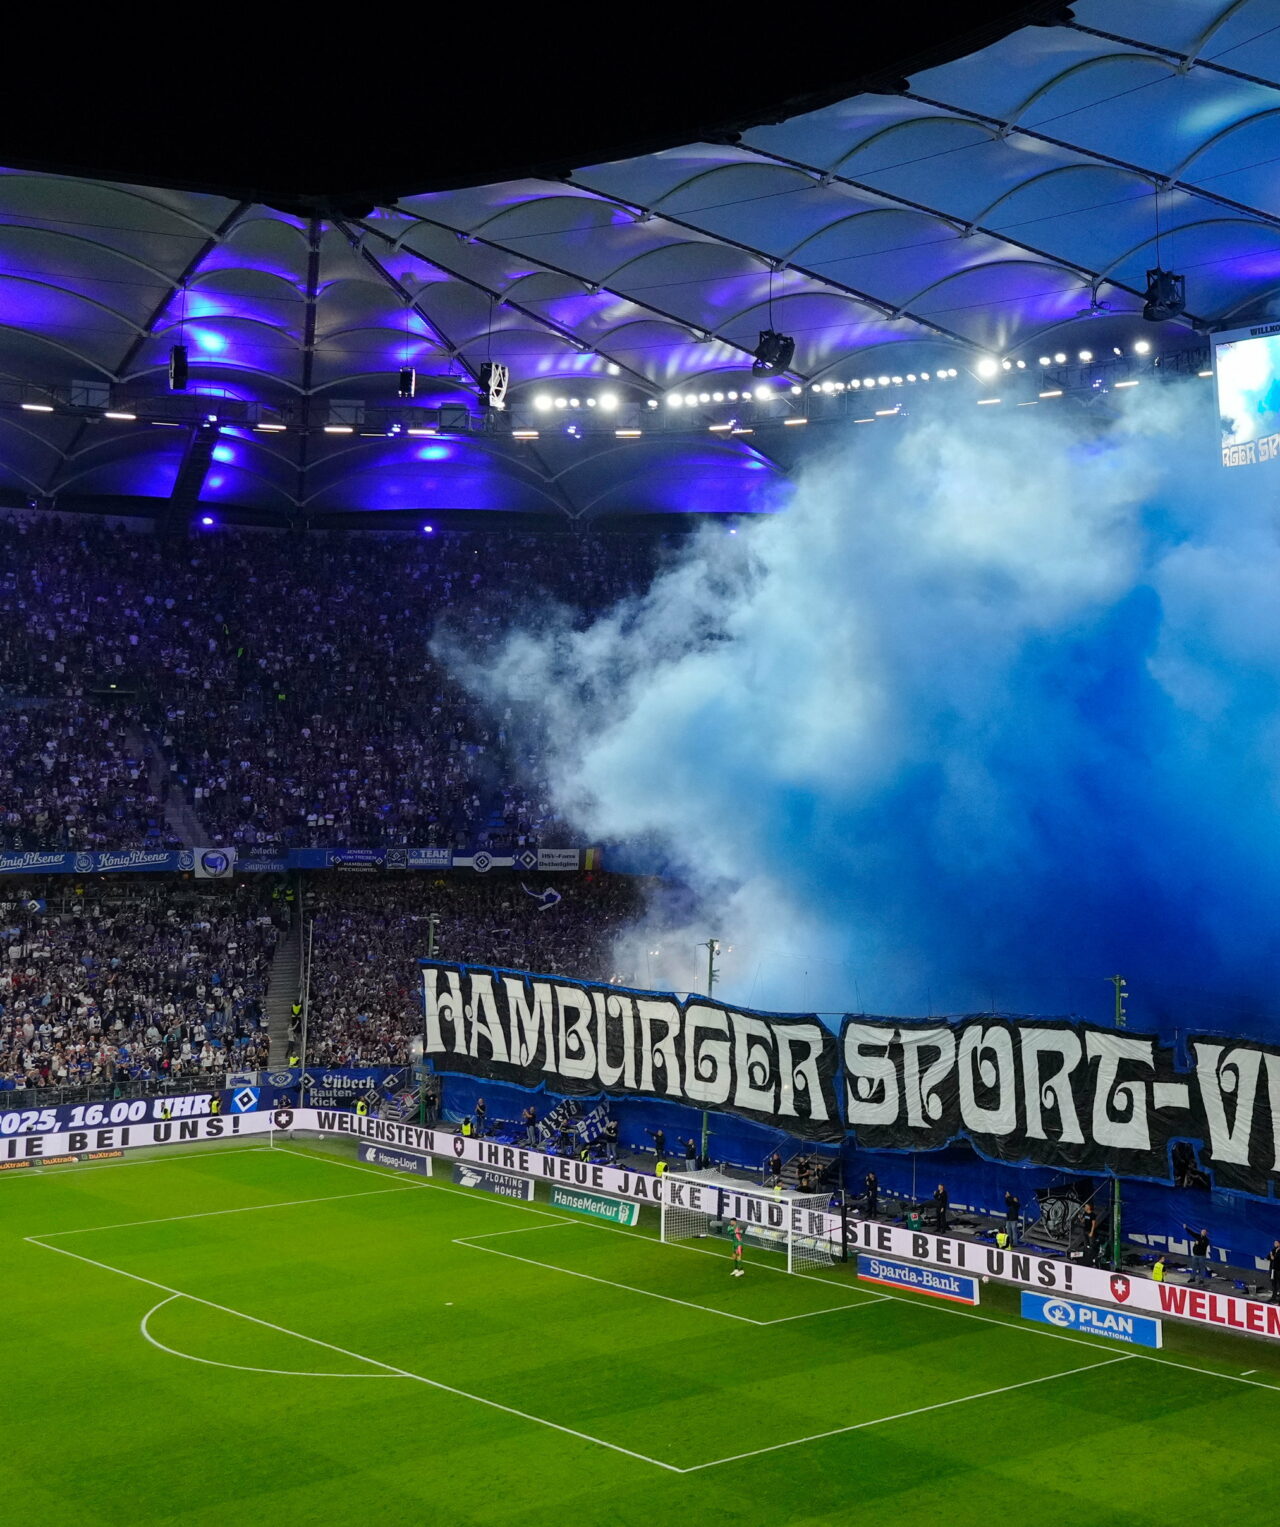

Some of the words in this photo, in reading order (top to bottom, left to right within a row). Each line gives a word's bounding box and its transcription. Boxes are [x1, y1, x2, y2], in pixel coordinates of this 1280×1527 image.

[23, 850, 65, 865] Pilsener
[98, 853, 131, 868] König
[129, 850, 170, 864] Pilsener
[420, 849, 449, 858] TEAM
[244, 862, 285, 872] Supporters
[421, 968, 830, 1121] HAMBURGER
[322, 1074, 375, 1088] Lübeck
[310, 1088, 356, 1098] Rauten-
[310, 1096, 337, 1107] Kick
[0, 1108, 62, 1134] 025,
[68, 1101, 147, 1128] 16.00
[153, 1094, 213, 1120] UHR
[317, 1111, 435, 1150] WELLENSTEYN
[68, 1127, 130, 1152] BEI
[88, 1150, 123, 1160] buXtrade
[378, 1153, 417, 1170] Hapag-Lloyd
[484, 1173, 523, 1189] FLOATING
[494, 1184, 523, 1199] HOMES
[554, 1190, 618, 1218] HanseMerkur
[478, 1142, 530, 1172] IHRE
[542, 1157, 604, 1188] NEUE
[617, 1173, 702, 1209] JACKE
[720, 1193, 825, 1237] FINDEN
[845, 1219, 892, 1252] SIE
[912, 1232, 966, 1268] BEI
[986, 1248, 1073, 1291] UNS!
[870, 1259, 961, 1293] Sparda-Bank
[1079, 1308, 1134, 1335] PLAN
[1079, 1325, 1134, 1343] INTERNATIONAL
